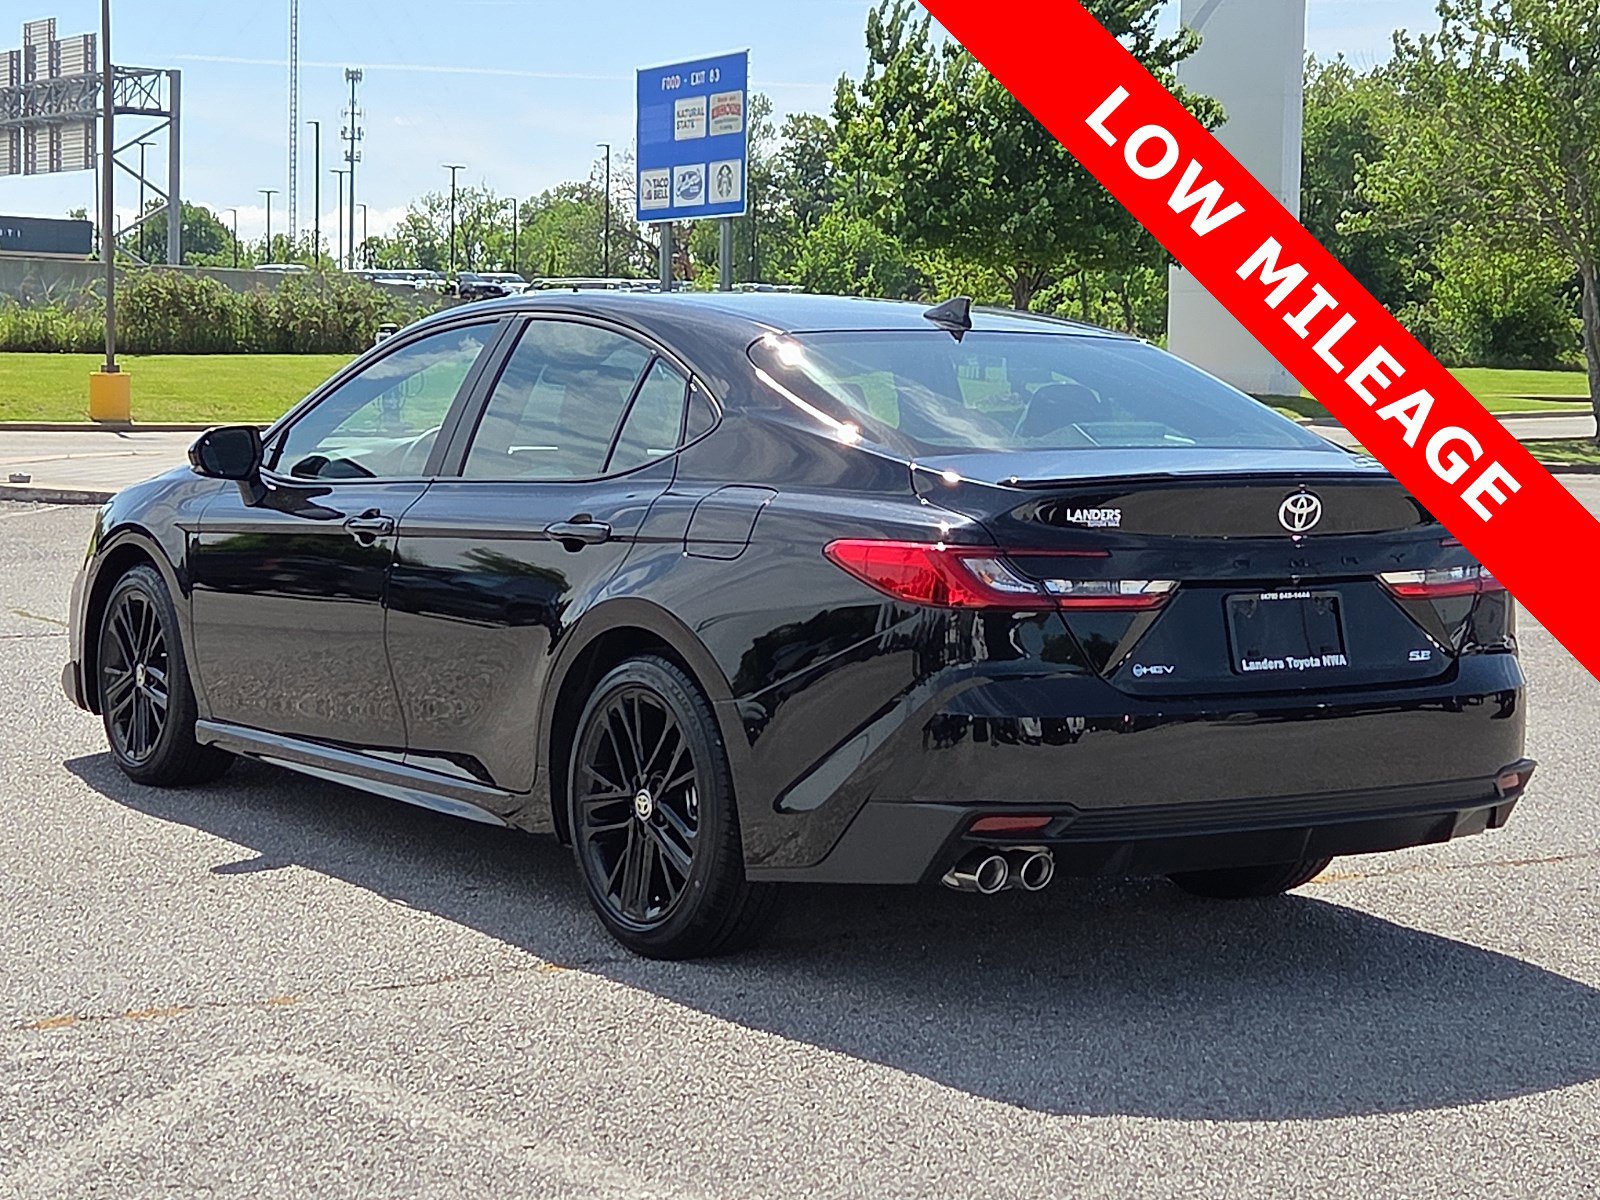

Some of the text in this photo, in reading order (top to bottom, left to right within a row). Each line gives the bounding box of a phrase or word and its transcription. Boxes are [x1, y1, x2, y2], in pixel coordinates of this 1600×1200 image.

[661, 74, 681, 91] FOOD
[690, 70, 706, 86] EXIT
[676, 107, 705, 118] NATURAL
[676, 118, 695, 130] STATE
[652, 177, 669, 188] TACO
[653, 189, 669, 200] BELL
[1066, 508, 1121, 521] LANDERS
[1408, 650, 1431, 661] SE
[1242, 654, 1347, 671] Landers Toyota NWA
